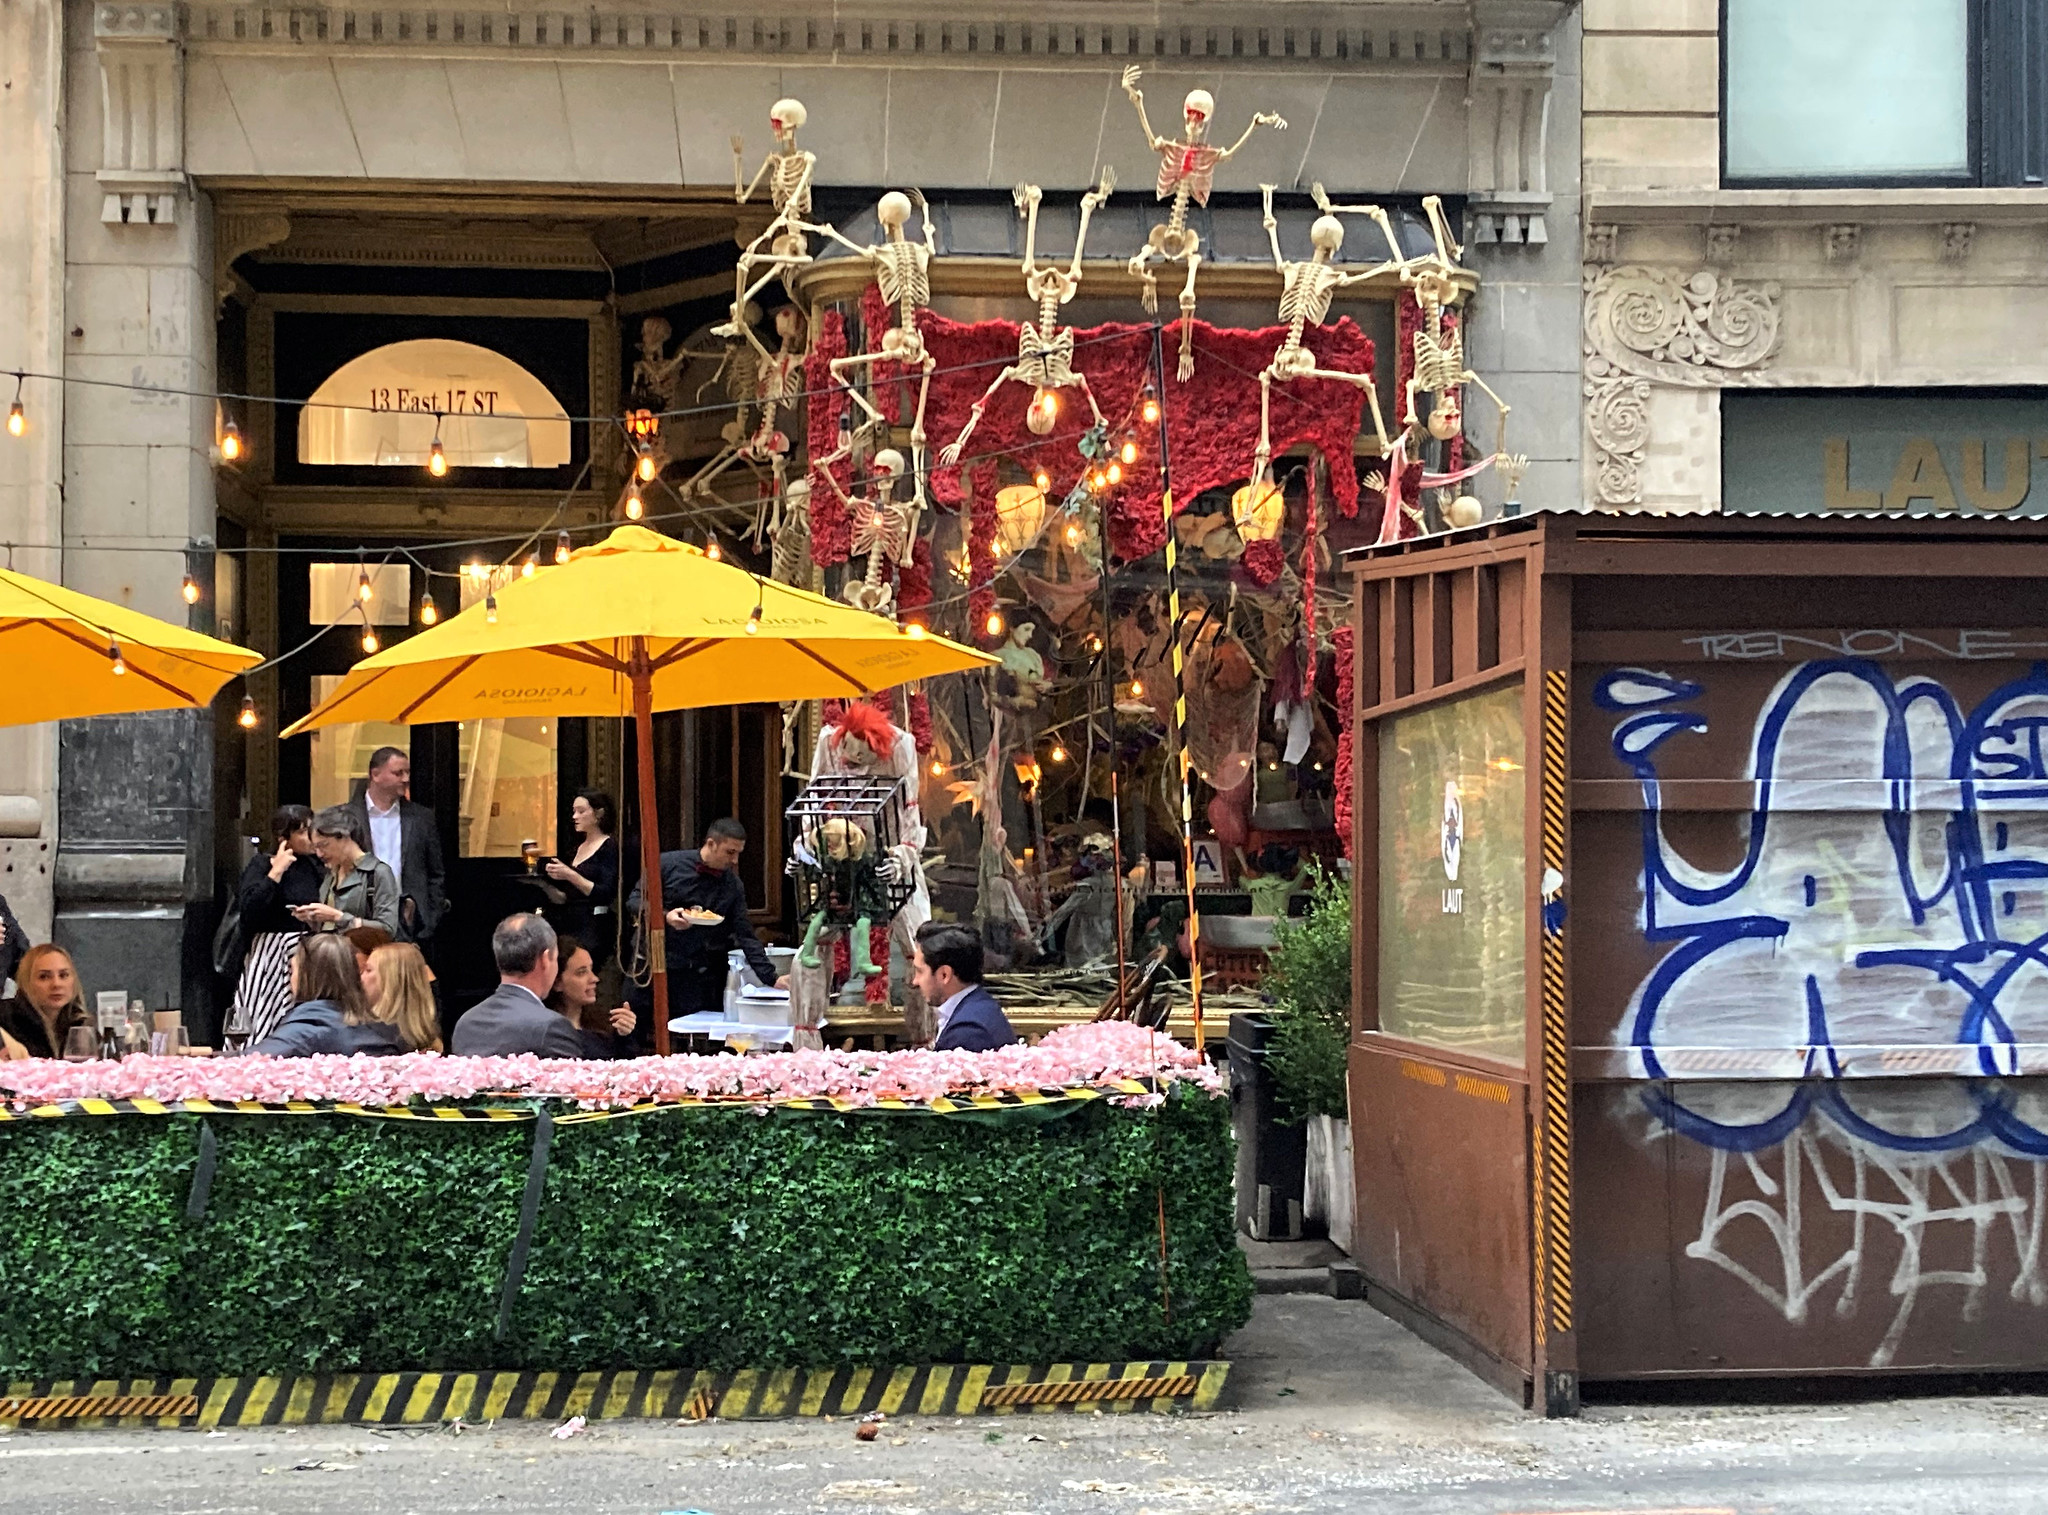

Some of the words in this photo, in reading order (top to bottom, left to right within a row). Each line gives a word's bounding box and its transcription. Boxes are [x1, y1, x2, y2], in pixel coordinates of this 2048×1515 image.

[371, 388, 391, 413] 13
[446, 390, 467, 415] 17
[472, 390, 499, 416] ST
[1822, 436, 2048, 512] LAU
[1195, 844, 1218, 872] A
[1442, 888, 1463, 913] LAUT
